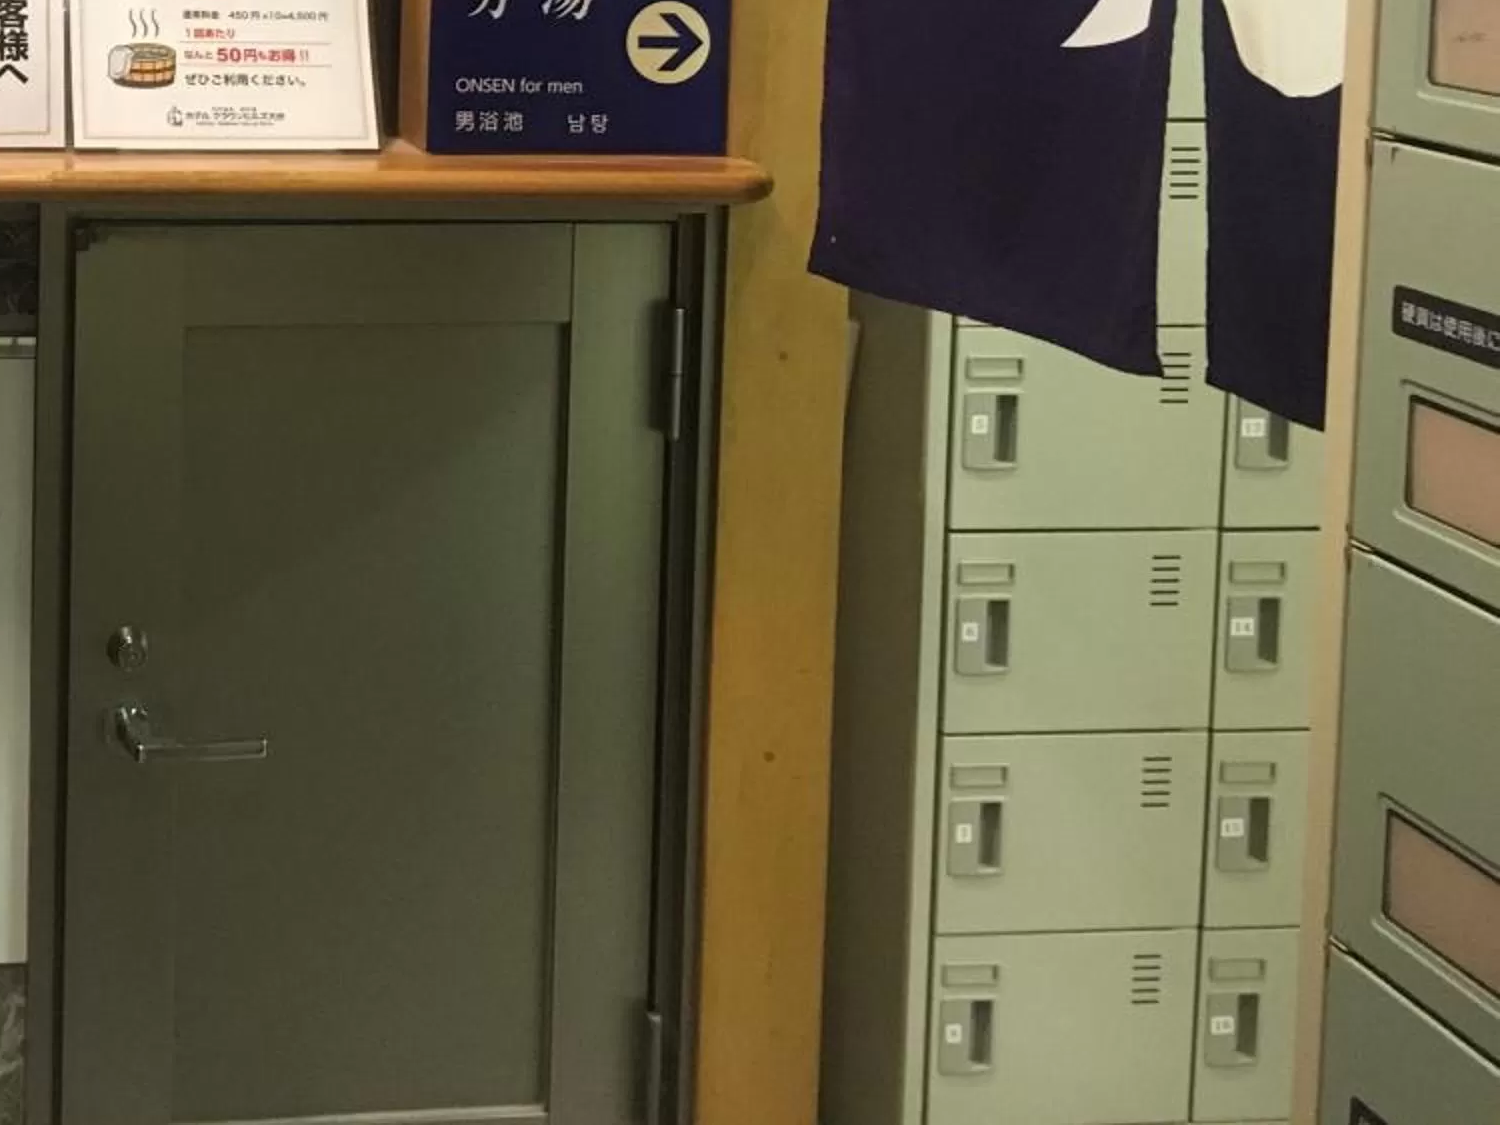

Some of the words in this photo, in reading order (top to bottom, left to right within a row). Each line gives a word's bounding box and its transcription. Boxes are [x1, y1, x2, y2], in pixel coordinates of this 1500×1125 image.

[455, 78, 516, 93] ONSEN
[520, 77, 541, 93] for
[547, 81, 583, 94] men
[455, 111, 524, 132] 男浴池
